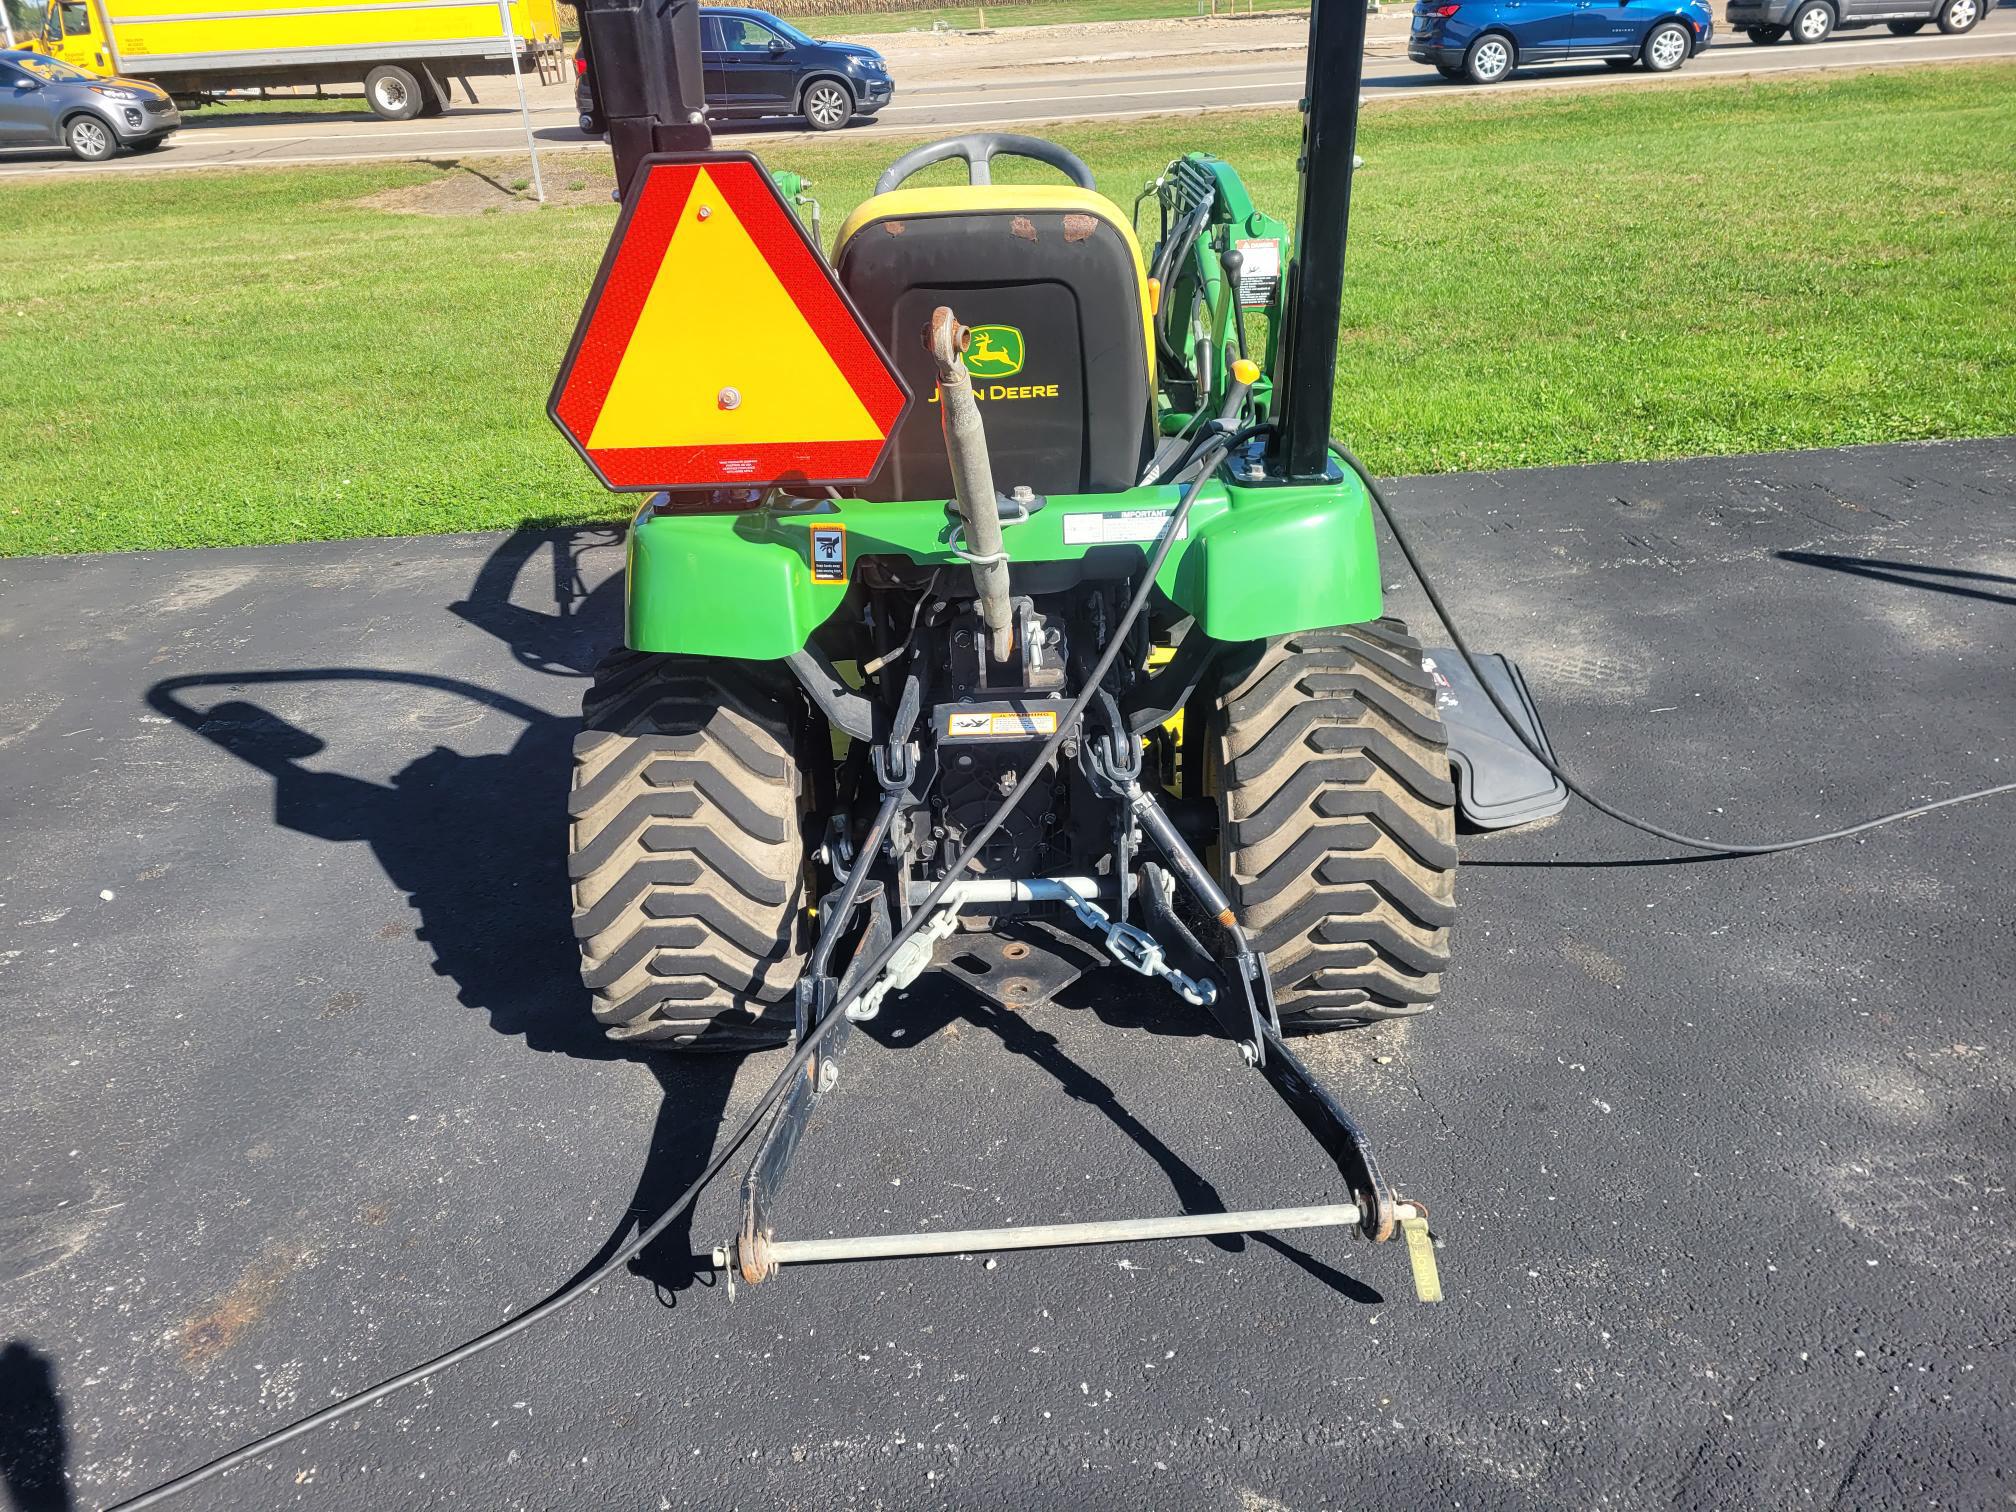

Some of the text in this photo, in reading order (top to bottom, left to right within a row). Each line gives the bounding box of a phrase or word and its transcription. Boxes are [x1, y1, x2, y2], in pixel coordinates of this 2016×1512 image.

[928, 385, 1059, 403] JN DEERE
[1121, 510, 1167, 518] IMPORTANT
